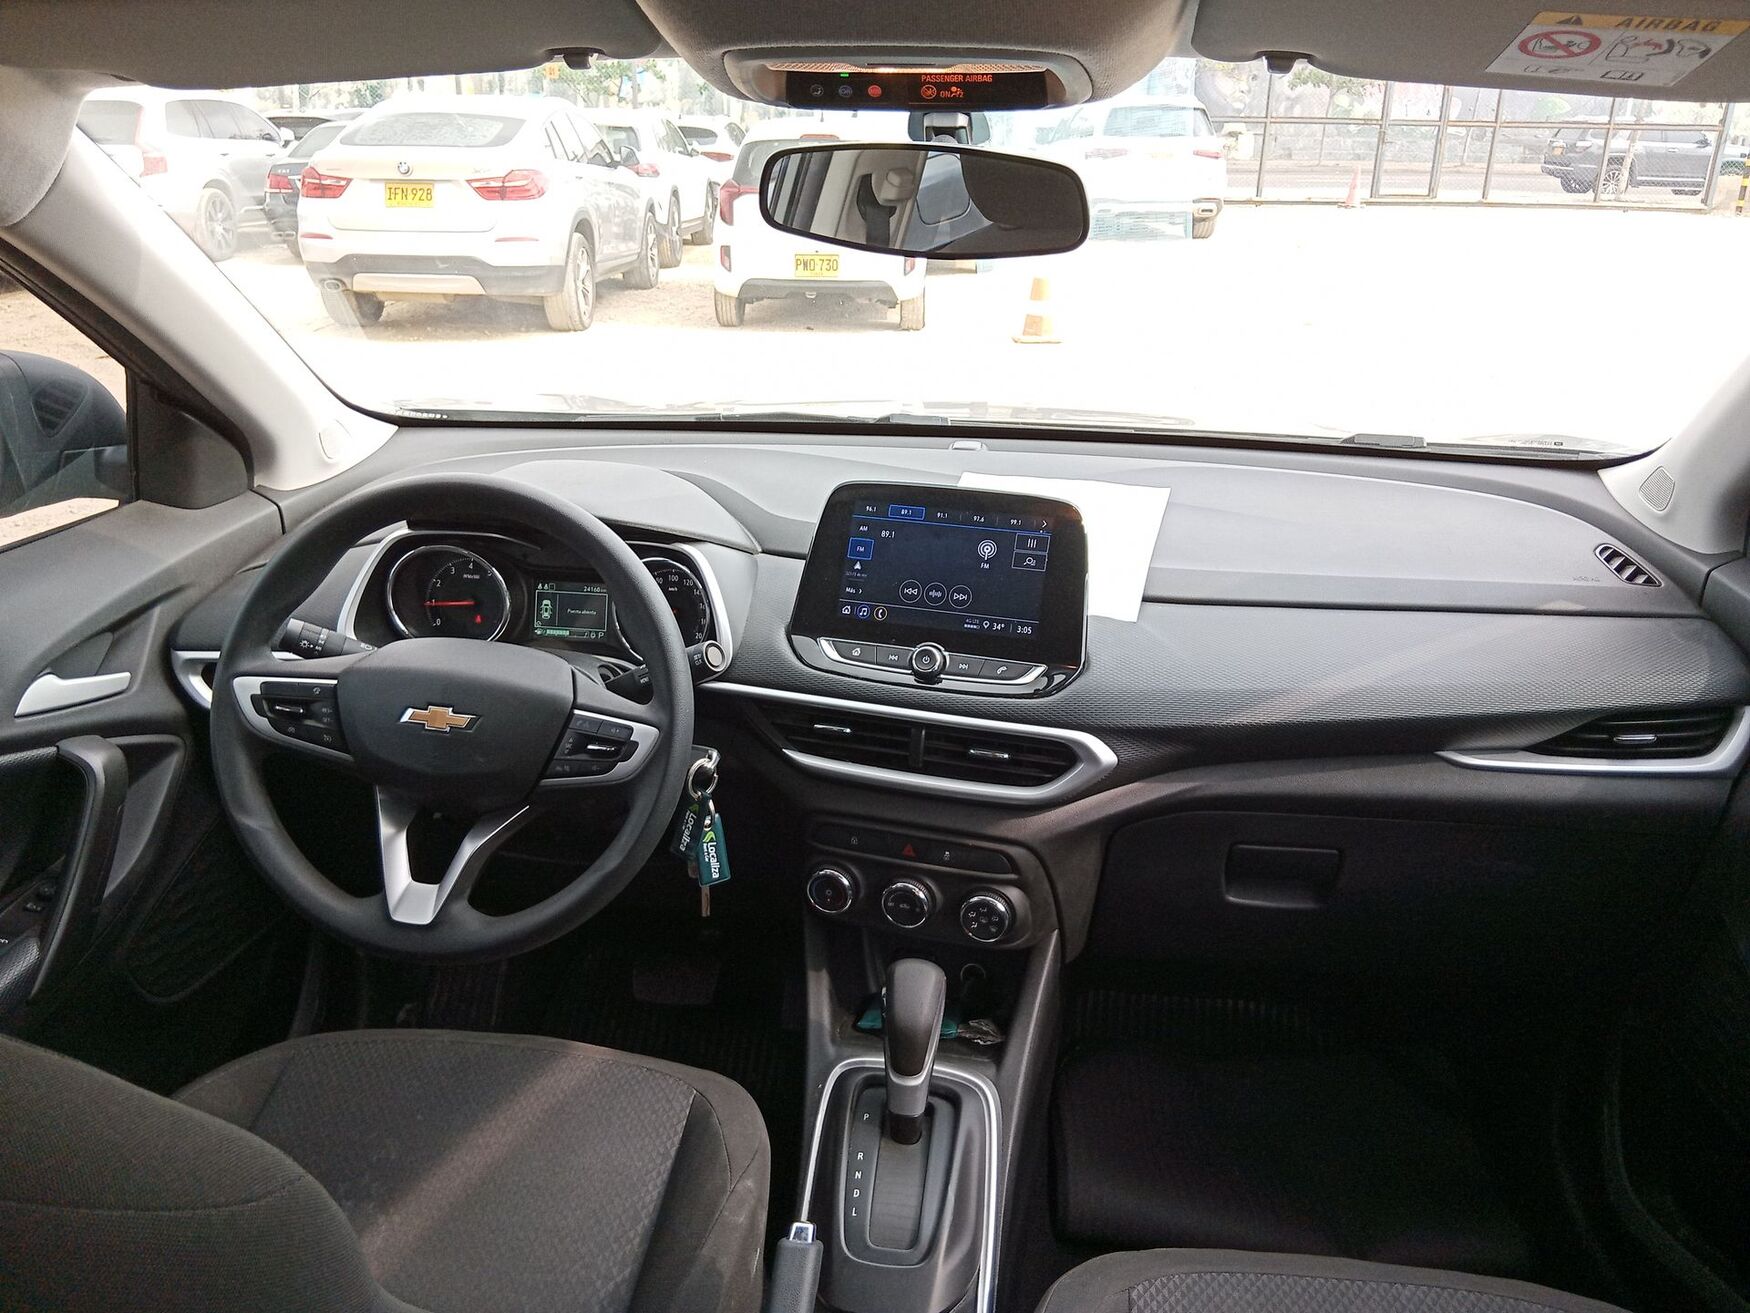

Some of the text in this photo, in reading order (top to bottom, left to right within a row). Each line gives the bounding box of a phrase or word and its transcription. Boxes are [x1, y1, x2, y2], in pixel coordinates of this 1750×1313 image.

[1615, 17, 1722, 32] AIRBAG
[921, 74, 993, 83] PASSENGER AIRBAG
[940, 90, 951, 98] ON
[387, 187, 433, 202] IFN 928
[819, 258, 839, 272] 730
[881, 530, 895, 538] 89.1
[450, 566, 455, 575] 3
[668, 574, 679, 582] 100
[436, 579, 441, 587] 2
[436, 618, 441, 626] 0
[1016, 625, 1032, 635] 3:05
[679, 812, 697, 852] Localiza
[707, 841, 720, 879] Localiza
[863, 1112, 870, 1120] P
[857, 1152, 864, 1160] R
[854, 1170, 862, 1179] N
[853, 1189, 860, 1198] D
[851, 1207, 857, 1216] L
